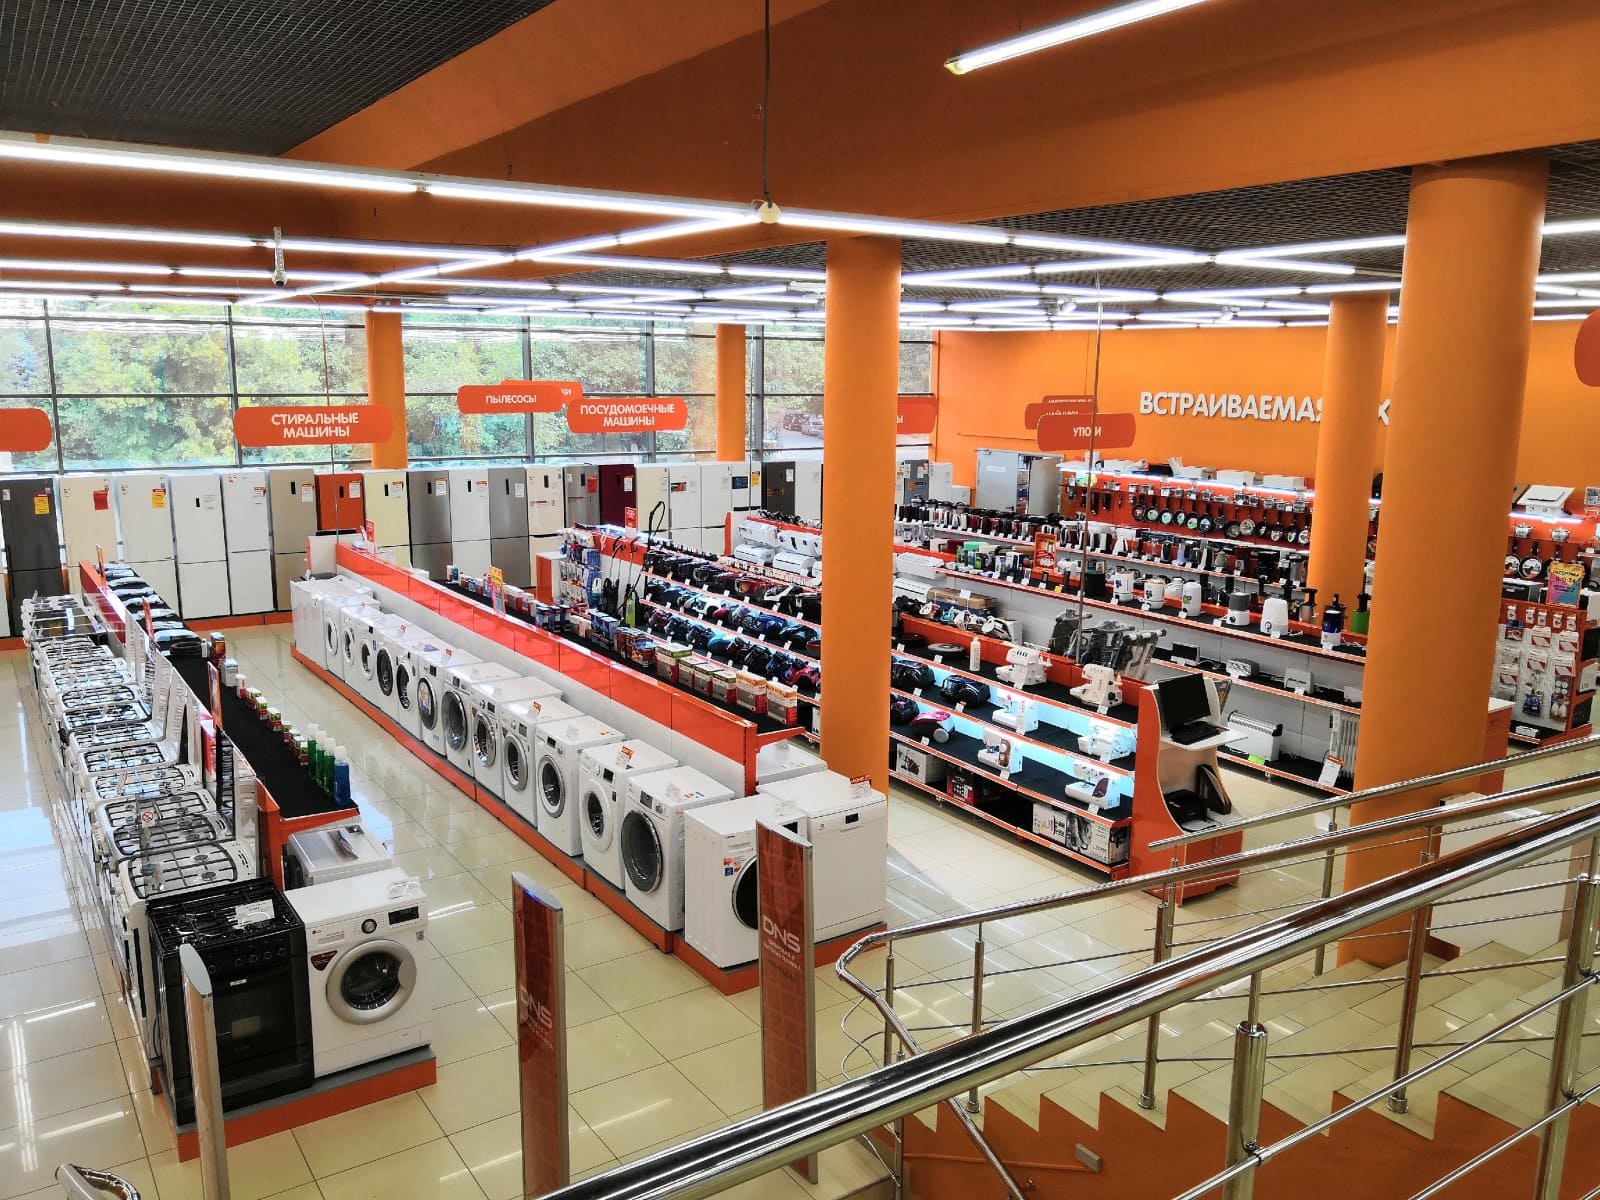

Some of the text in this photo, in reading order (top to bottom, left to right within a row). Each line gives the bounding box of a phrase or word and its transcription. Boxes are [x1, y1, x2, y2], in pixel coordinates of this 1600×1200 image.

[485, 394, 537, 404] ПЫЛЕСОСЫ
[580, 403, 675, 415] ПОСУДОМОЕЧНЫЕ
[271, 412, 360, 425] СТИРАЛЬНЫЕ
[603, 416, 655, 427] МАШИНЫ
[283, 425, 350, 438] МАШИНЫ
[1073, 426, 1102, 438] УТЮИ
[763, 914, 801, 954] DNS
[519, 983, 553, 1030] DNS
